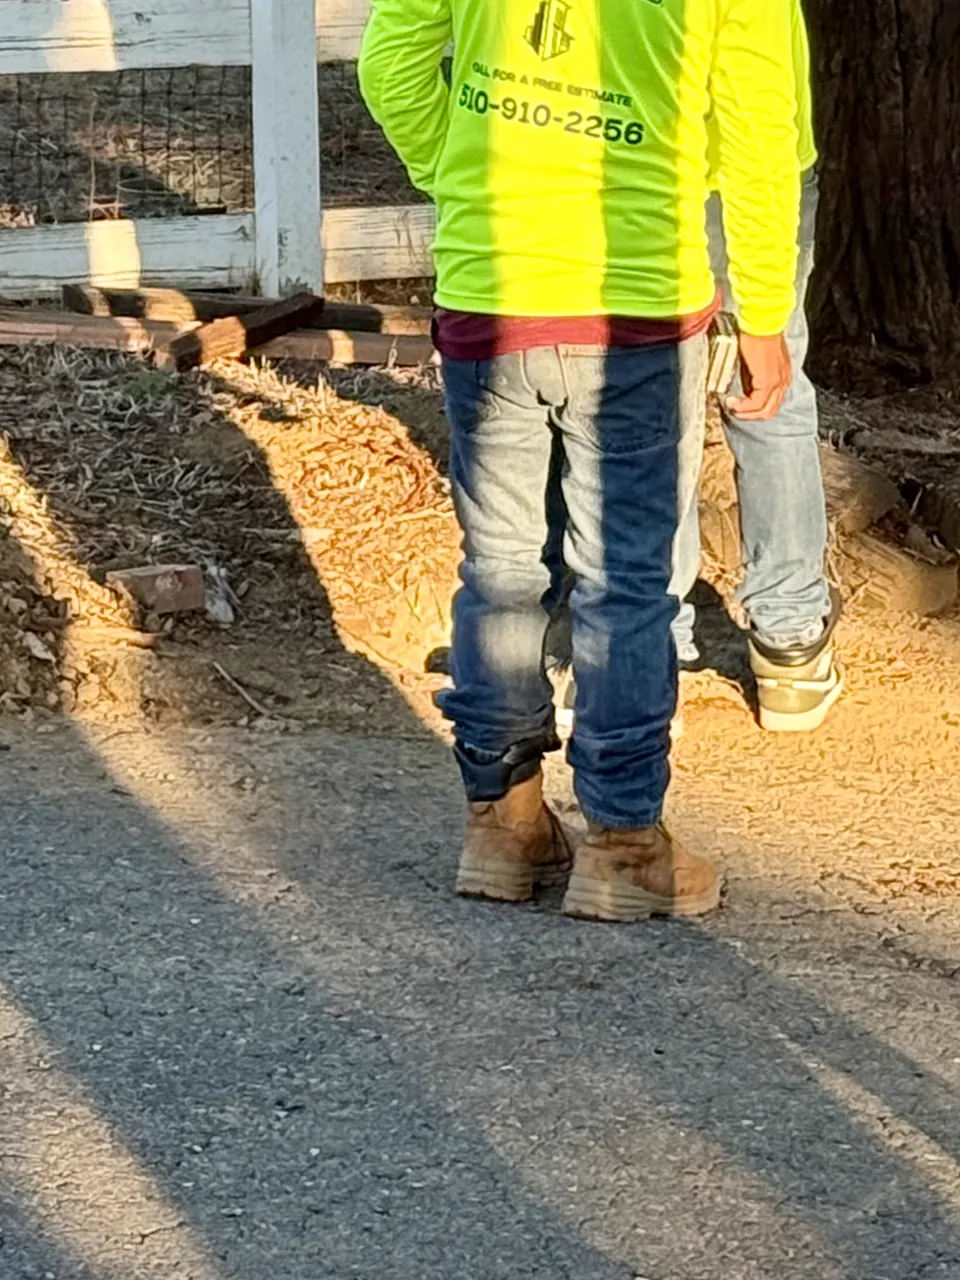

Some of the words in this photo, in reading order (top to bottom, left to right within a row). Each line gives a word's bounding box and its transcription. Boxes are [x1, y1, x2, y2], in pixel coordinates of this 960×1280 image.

[458, 82, 645, 145] 510-910-2256
[492, 67, 516, 83] FOR
[519, 74, 529, 85] A
[567, 84, 633, 108] ESTIMATE
